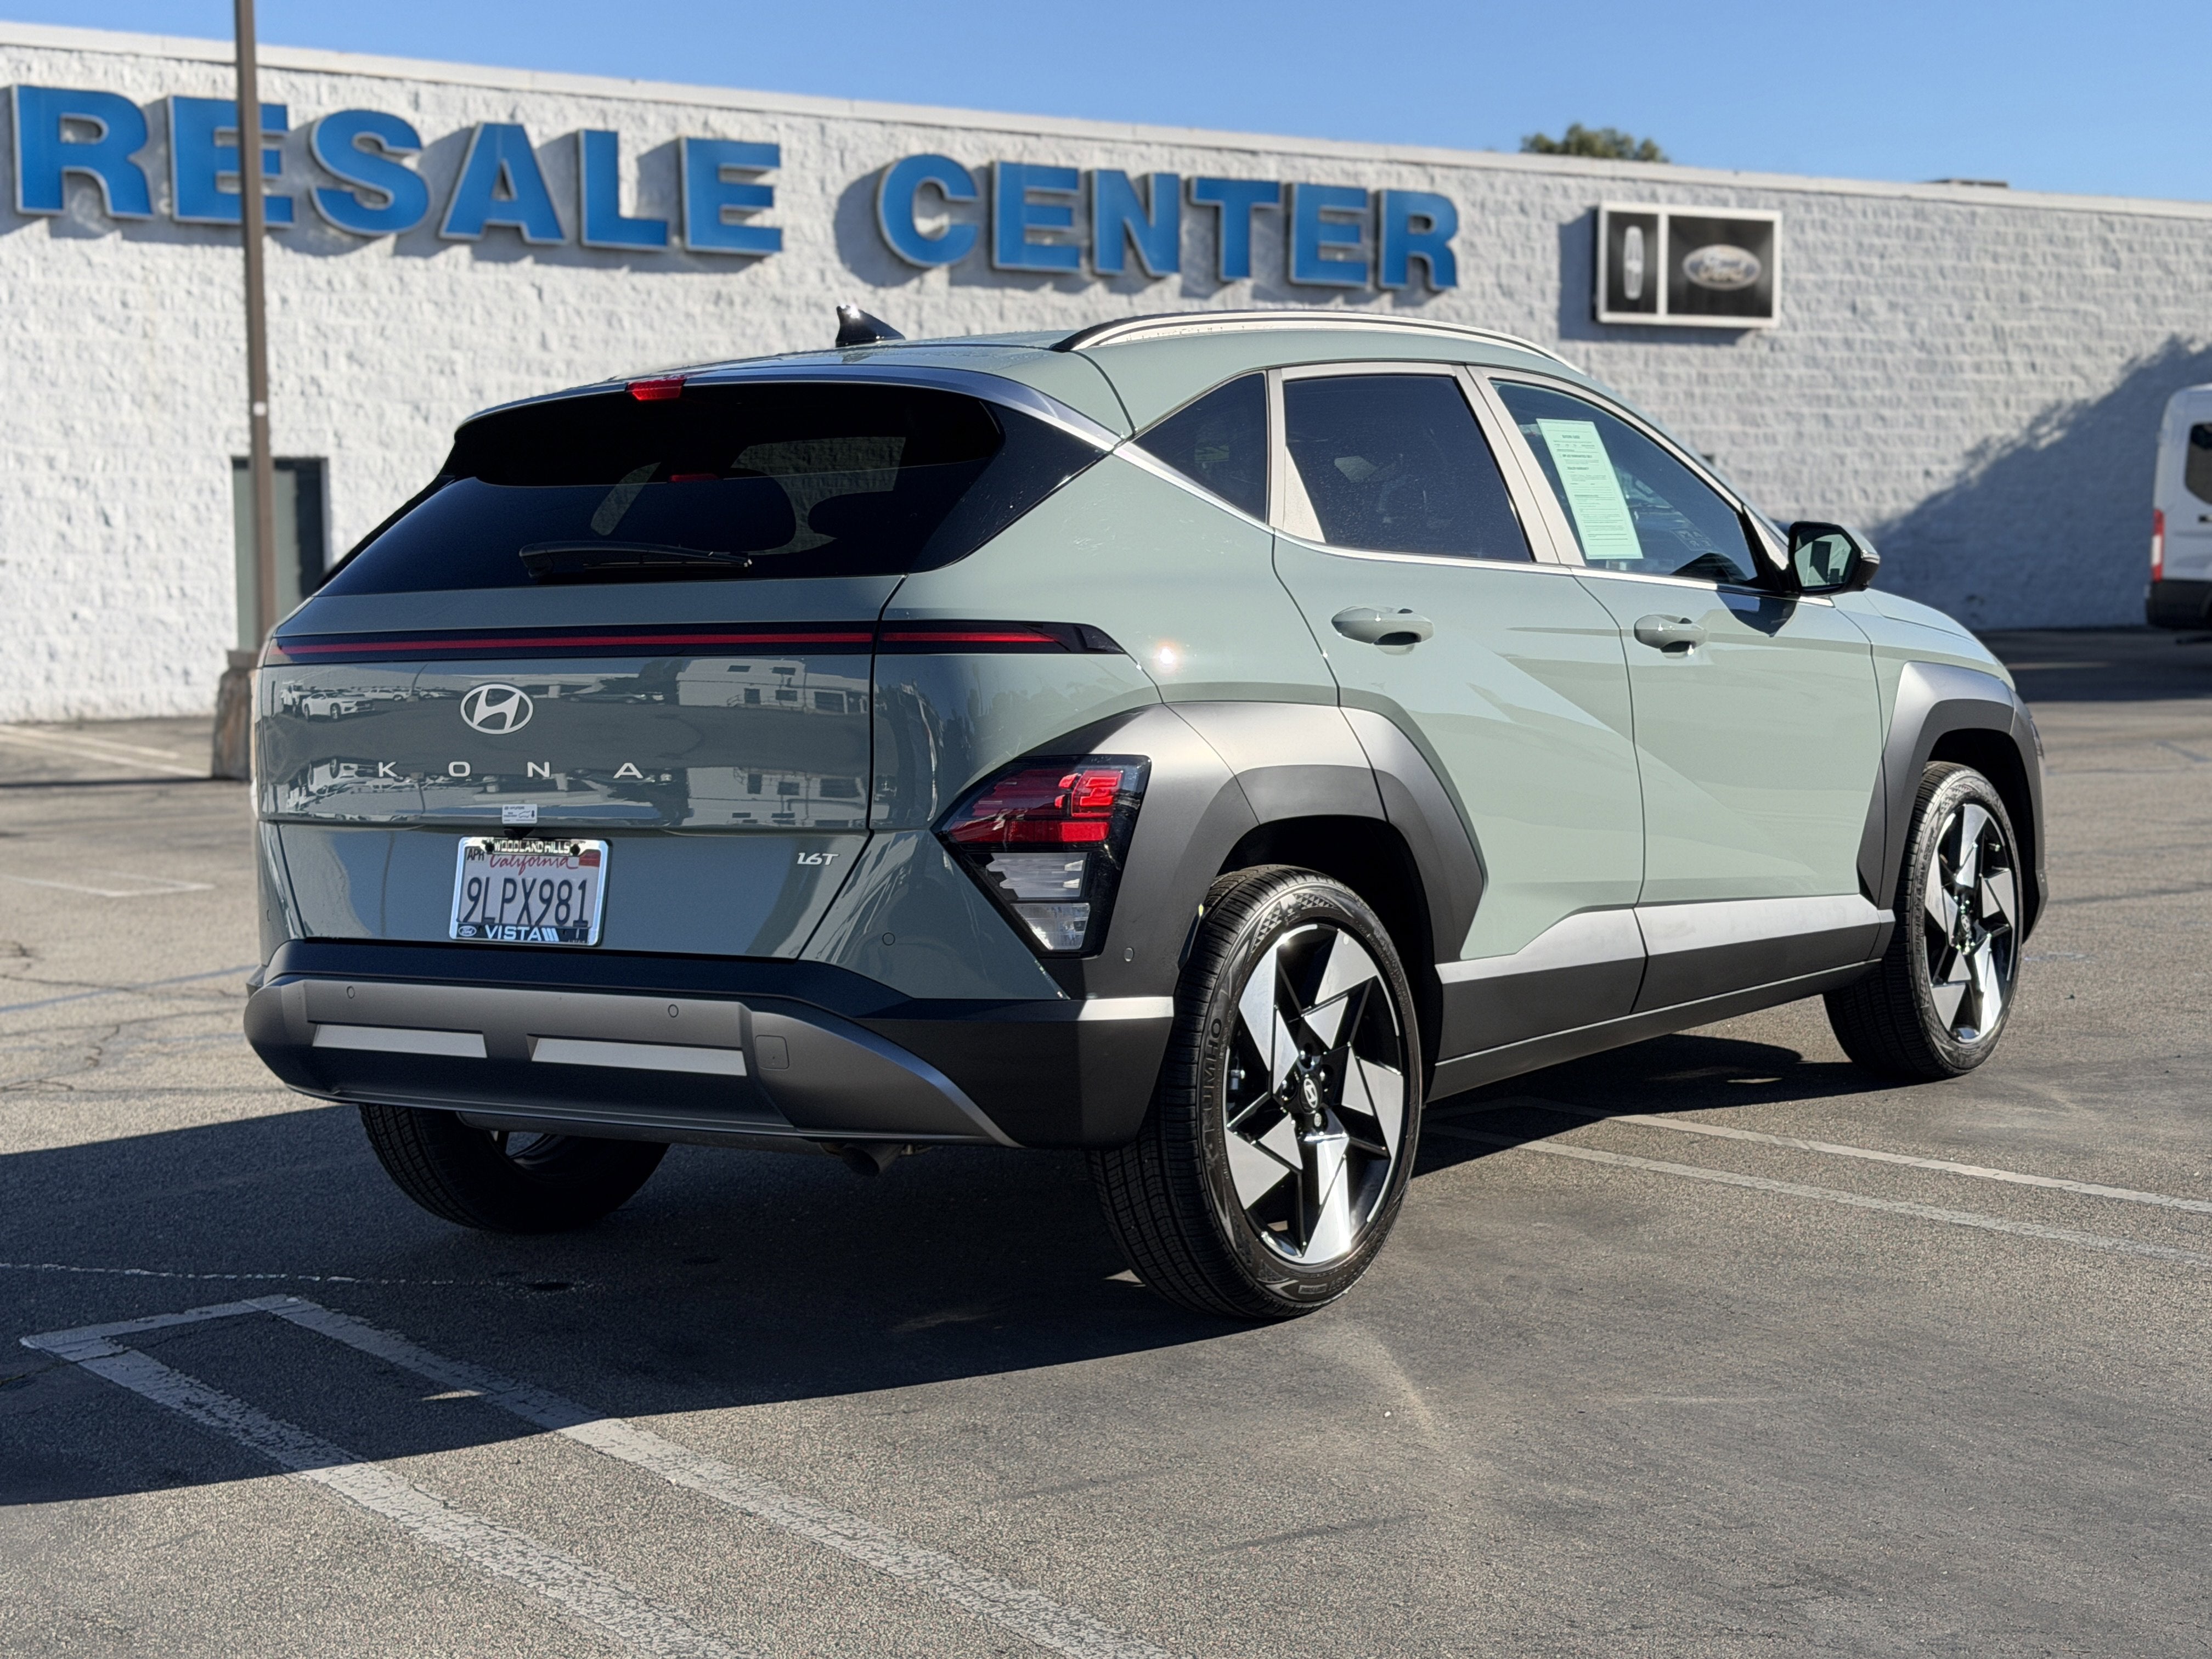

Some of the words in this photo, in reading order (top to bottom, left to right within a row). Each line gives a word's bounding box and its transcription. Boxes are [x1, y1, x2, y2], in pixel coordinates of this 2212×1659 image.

[12, 83, 783, 256] RESALE
[879, 153, 1459, 290] CENTER
[377, 761, 644, 779] KONA
[494, 839, 544, 853] WOODLAND
[544, 840, 571, 854] HILLS
[489, 854, 579, 876] California
[462, 876, 589, 928] 9LPX981
[484, 924, 542, 941] VISTA
